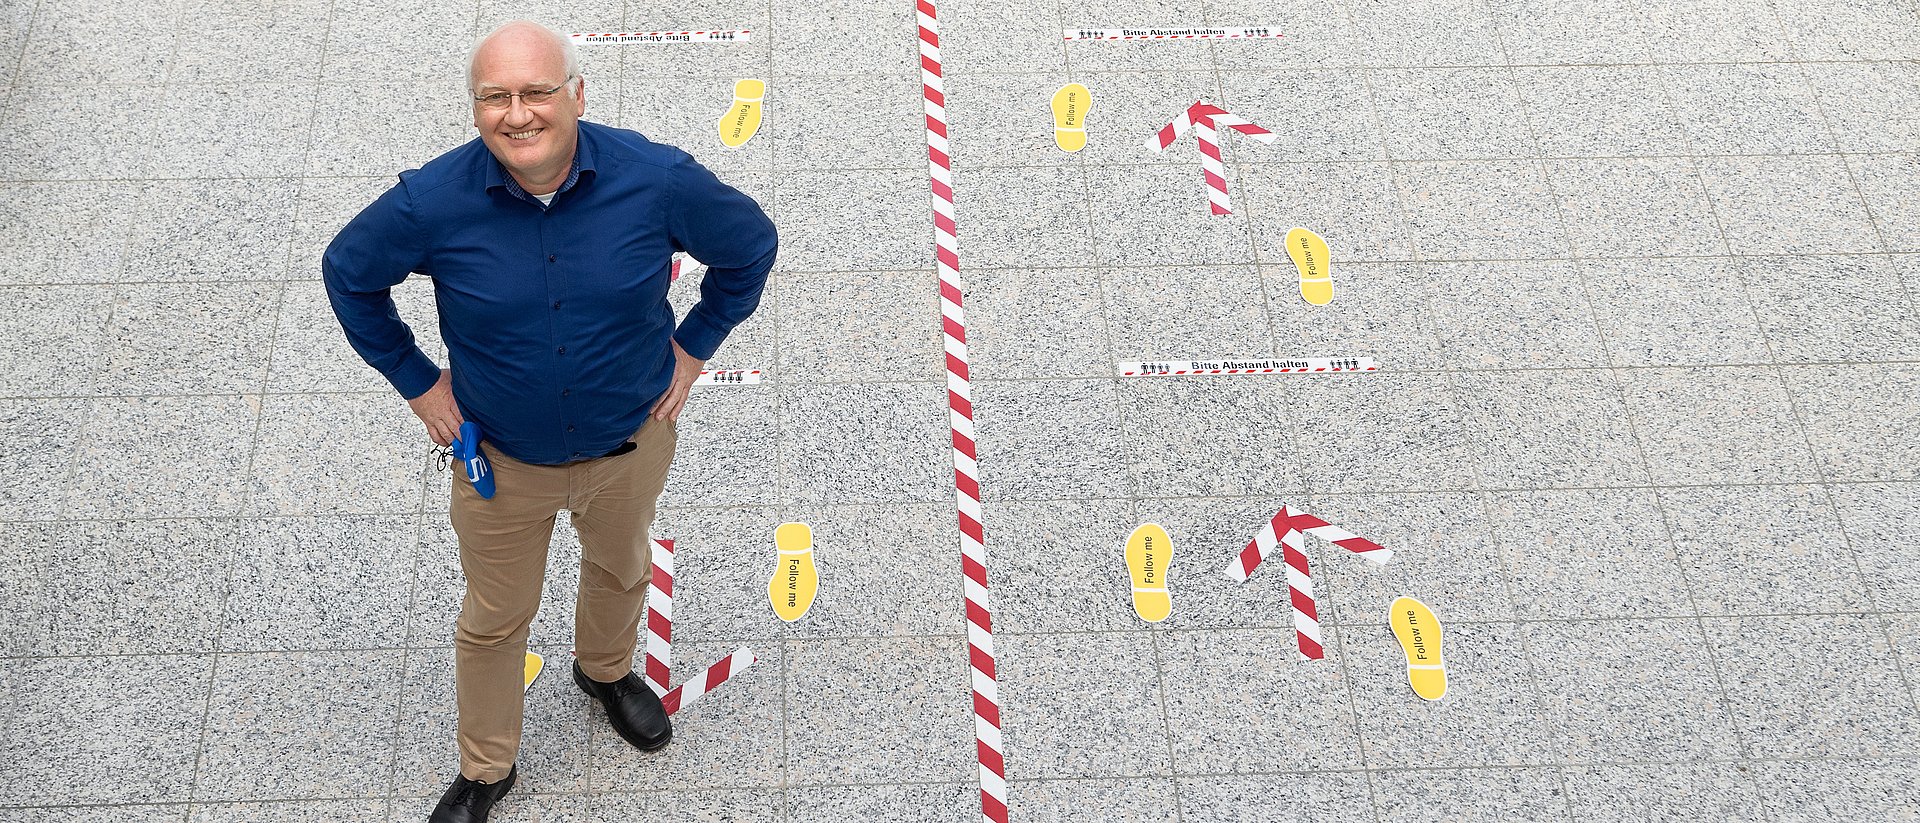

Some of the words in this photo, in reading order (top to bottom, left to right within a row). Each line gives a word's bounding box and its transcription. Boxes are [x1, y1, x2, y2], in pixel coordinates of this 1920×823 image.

[621, 35, 663, 43] Abstand
[1123, 29, 1147, 37] Bitte
[1069, 92, 1076, 102] me
[737, 104, 751, 126] Follow
[1066, 104, 1075, 126] Follow
[733, 127, 741, 138] me
[1300, 237, 1309, 249] me
[1305, 251, 1317, 276] Follow
[1191, 361, 1219, 370] Bitte
[1222, 360, 1269, 370] Abstand
[1272, 359, 1309, 369] halten
[1144, 536, 1153, 551] me
[788, 559, 800, 590] Follow
[1144, 553, 1154, 584] Follow
[788, 593, 796, 608] me
[1407, 610, 1417, 625] me
[1412, 628, 1427, 660] Follow
